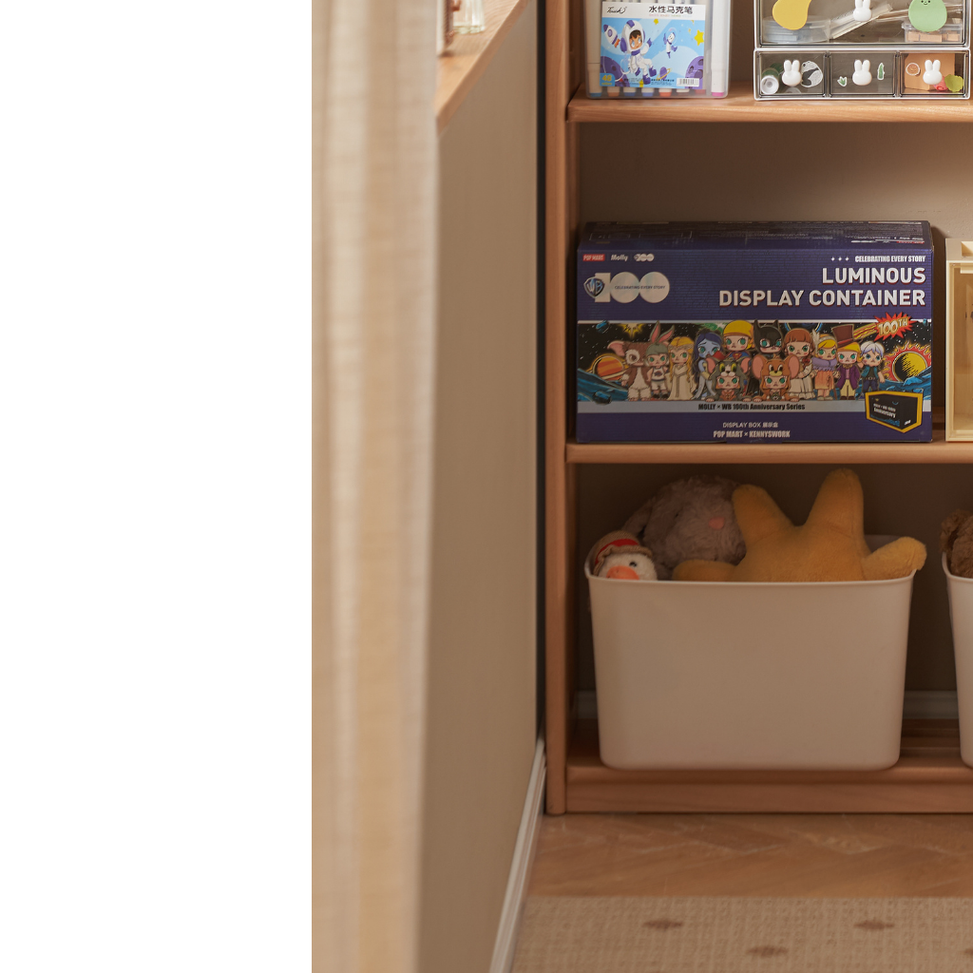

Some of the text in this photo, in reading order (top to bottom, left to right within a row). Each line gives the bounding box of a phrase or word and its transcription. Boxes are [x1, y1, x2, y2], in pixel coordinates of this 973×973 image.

[648, 5, 694, 14] 水性马克笔
[602, 74, 612, 82] 48
[610, 254, 629, 262] Molly
[908, 255, 926, 263] STORY
[822, 267, 926, 285] LUMINOUS
[719, 289, 926, 307] DISPLAY CONTAINER
[698, 403, 716, 411] MOLLY
[733, 403, 749, 411] 100th
[750, 403, 786, 411] Anniversary
[786, 403, 805, 411] Series
[713, 430, 726, 438] POP
[726, 430, 743, 438] MART
[749, 430, 791, 438] KENNYSWORK
